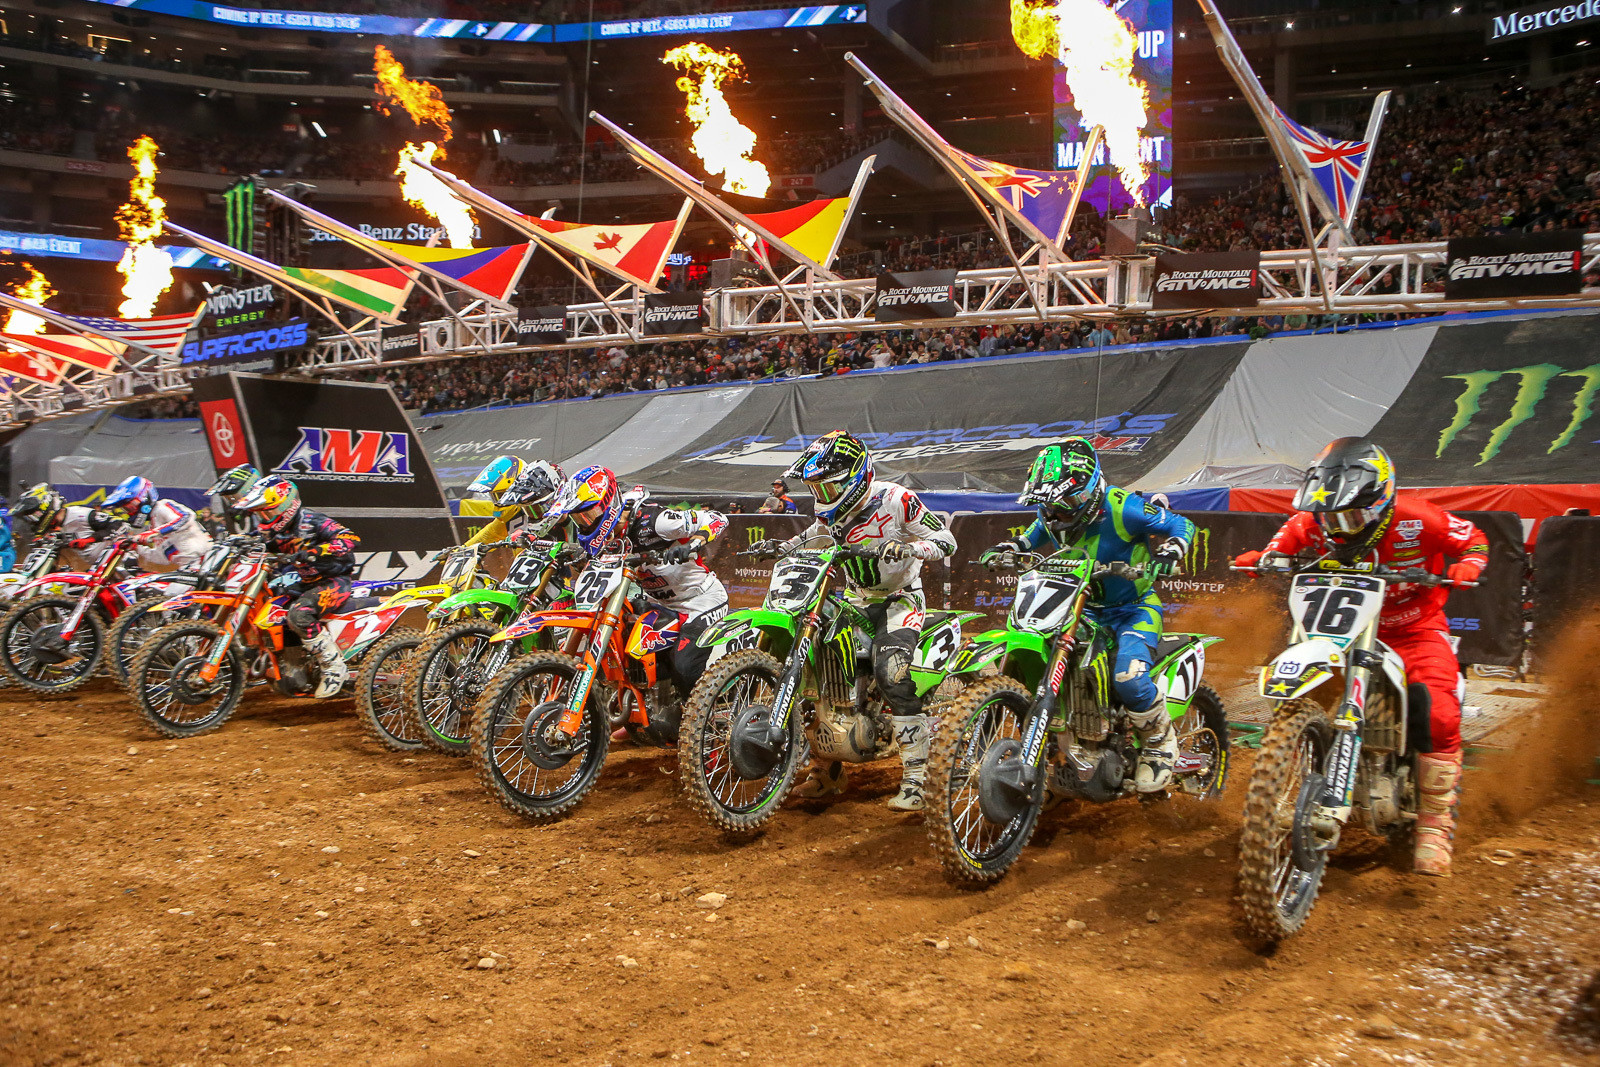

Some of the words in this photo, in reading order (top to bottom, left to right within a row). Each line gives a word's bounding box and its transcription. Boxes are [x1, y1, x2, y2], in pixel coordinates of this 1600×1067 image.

[1137, 29, 1165, 59] UP
[1057, 138, 1105, 168] MAN
[1171, 271, 1201, 279] ROCKY
[1201, 269, 1252, 279] MOUNTAIN
[1469, 255, 1508, 266] ROCKY
[1506, 250, 1575, 264] MOUNTAIN
[206, 284, 274, 315] MONSTER
[888, 287, 911, 295] ROCKY
[911, 285, 949, 294] MOUNTAIN
[216, 310, 266, 327] ENERGY
[182, 322, 309, 364] SUPERCROSS
[433, 437, 541, 455] MONSTER
[777, 411, 1179, 450] SPERCROSS
[271, 426, 414, 477] AMA
[589, 528, 609, 548] Red
[602, 508, 617, 530] Bull
[226, 563, 254, 589] 2
[575, 571, 614, 604] 25
[770, 565, 820, 601] 3
[1161, 579, 1225, 593] MONSTER
[1017, 580, 1078, 620] 17
[1302, 587, 1365, 635] 16
[353, 613, 383, 643] 2
[930, 627, 956, 670] 3
[577, 668, 593, 702] MOTOREX
[776, 676, 796, 728] DUNLOP
[1027, 708, 1048, 767] DUNLOP
[1334, 733, 1353, 801] DUNLOP
